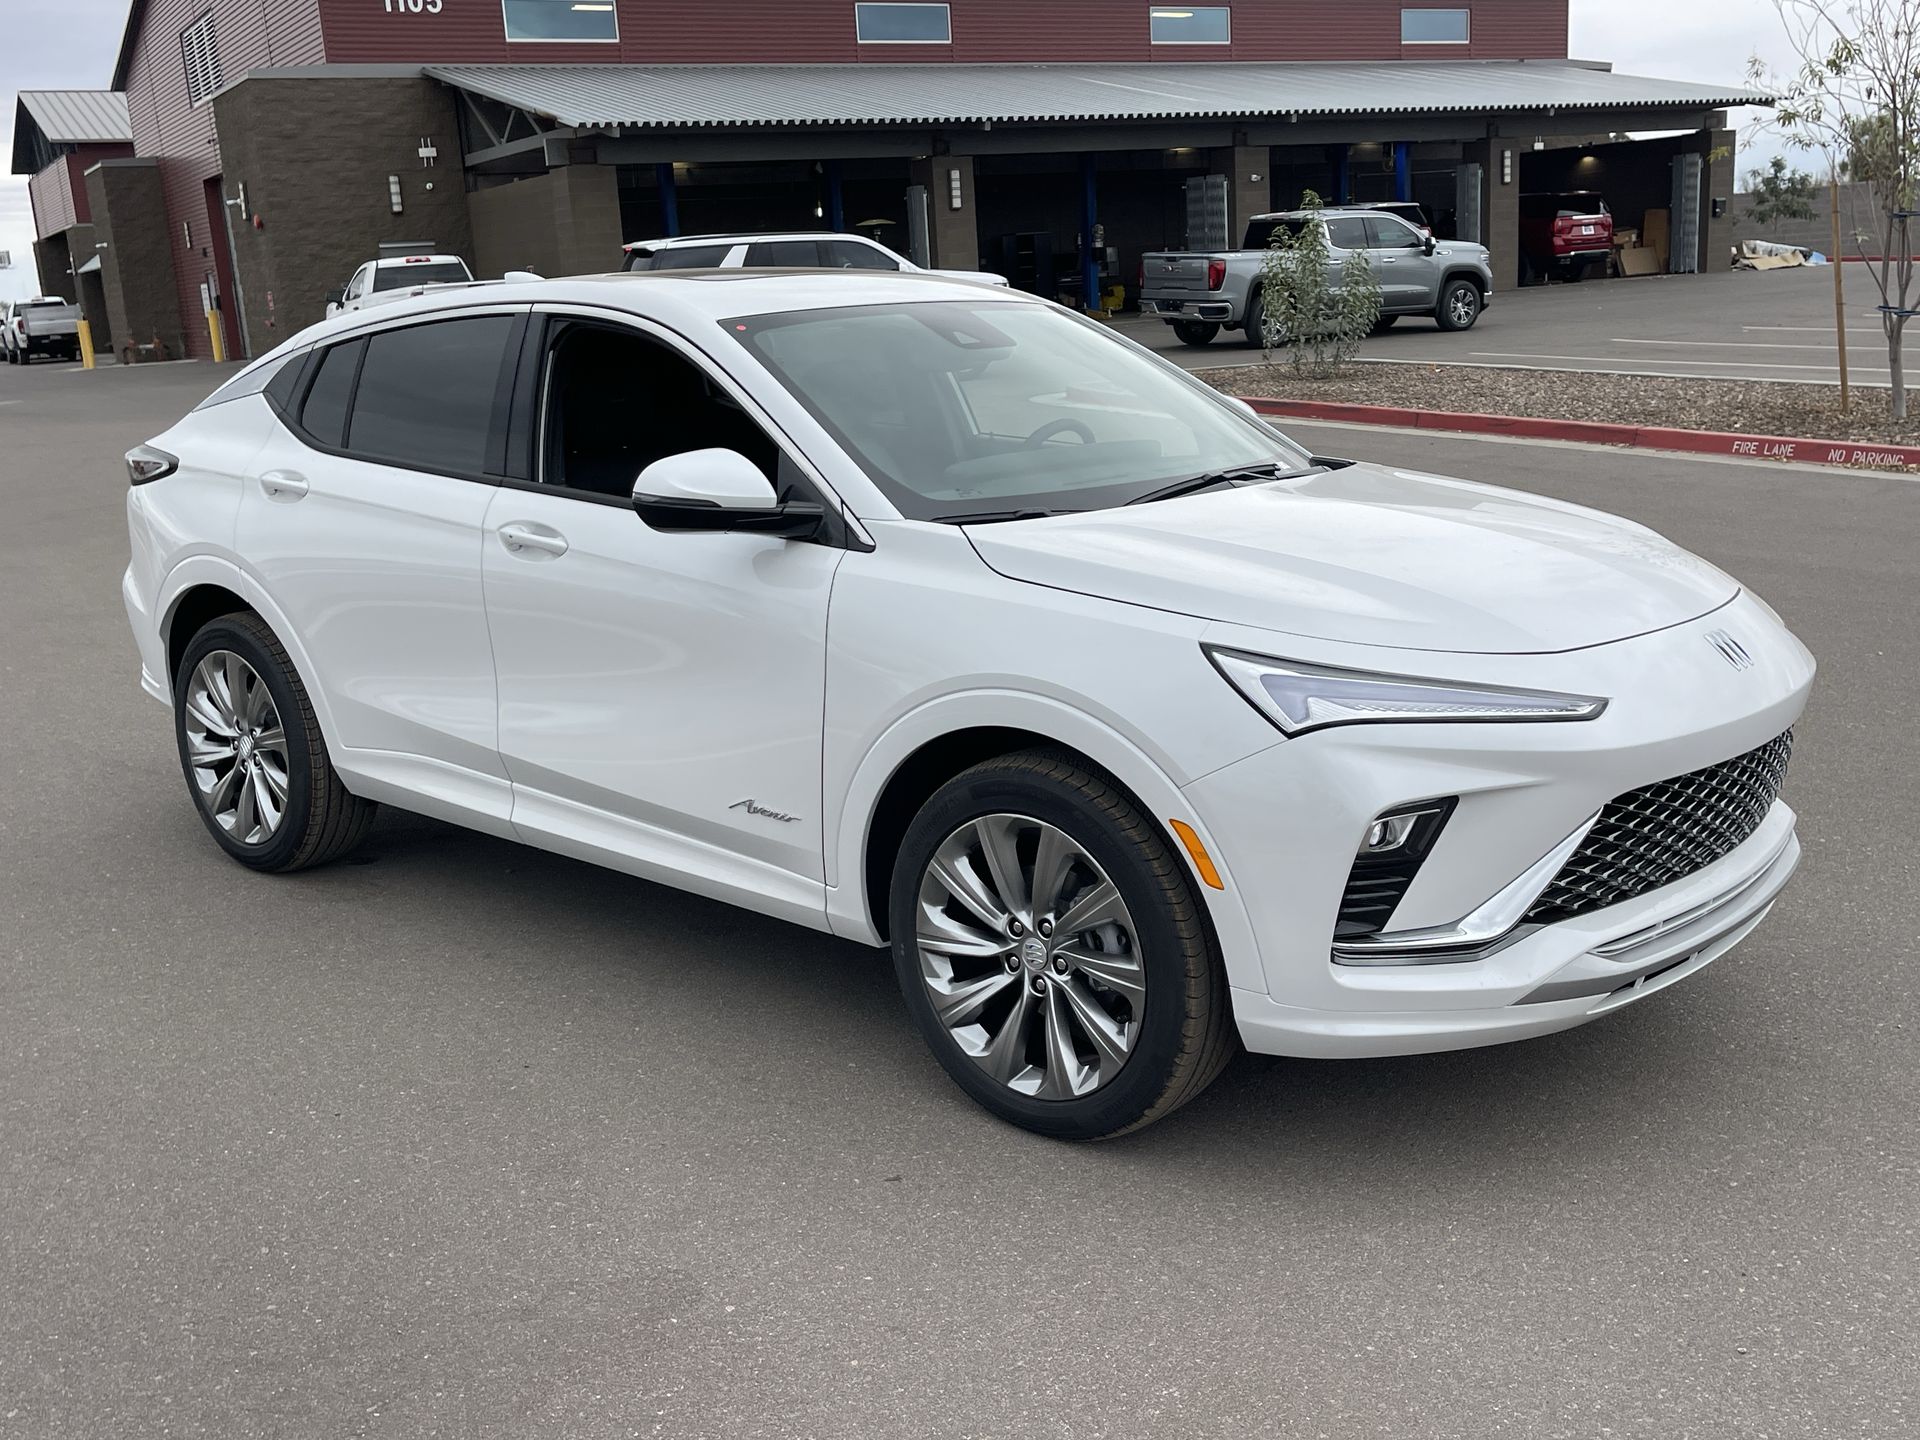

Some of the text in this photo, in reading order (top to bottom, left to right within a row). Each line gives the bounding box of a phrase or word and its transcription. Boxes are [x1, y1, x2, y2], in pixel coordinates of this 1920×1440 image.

[1732, 440, 1797, 457] FIRE LANE
[1827, 448, 1905, 466] NO PARKING
